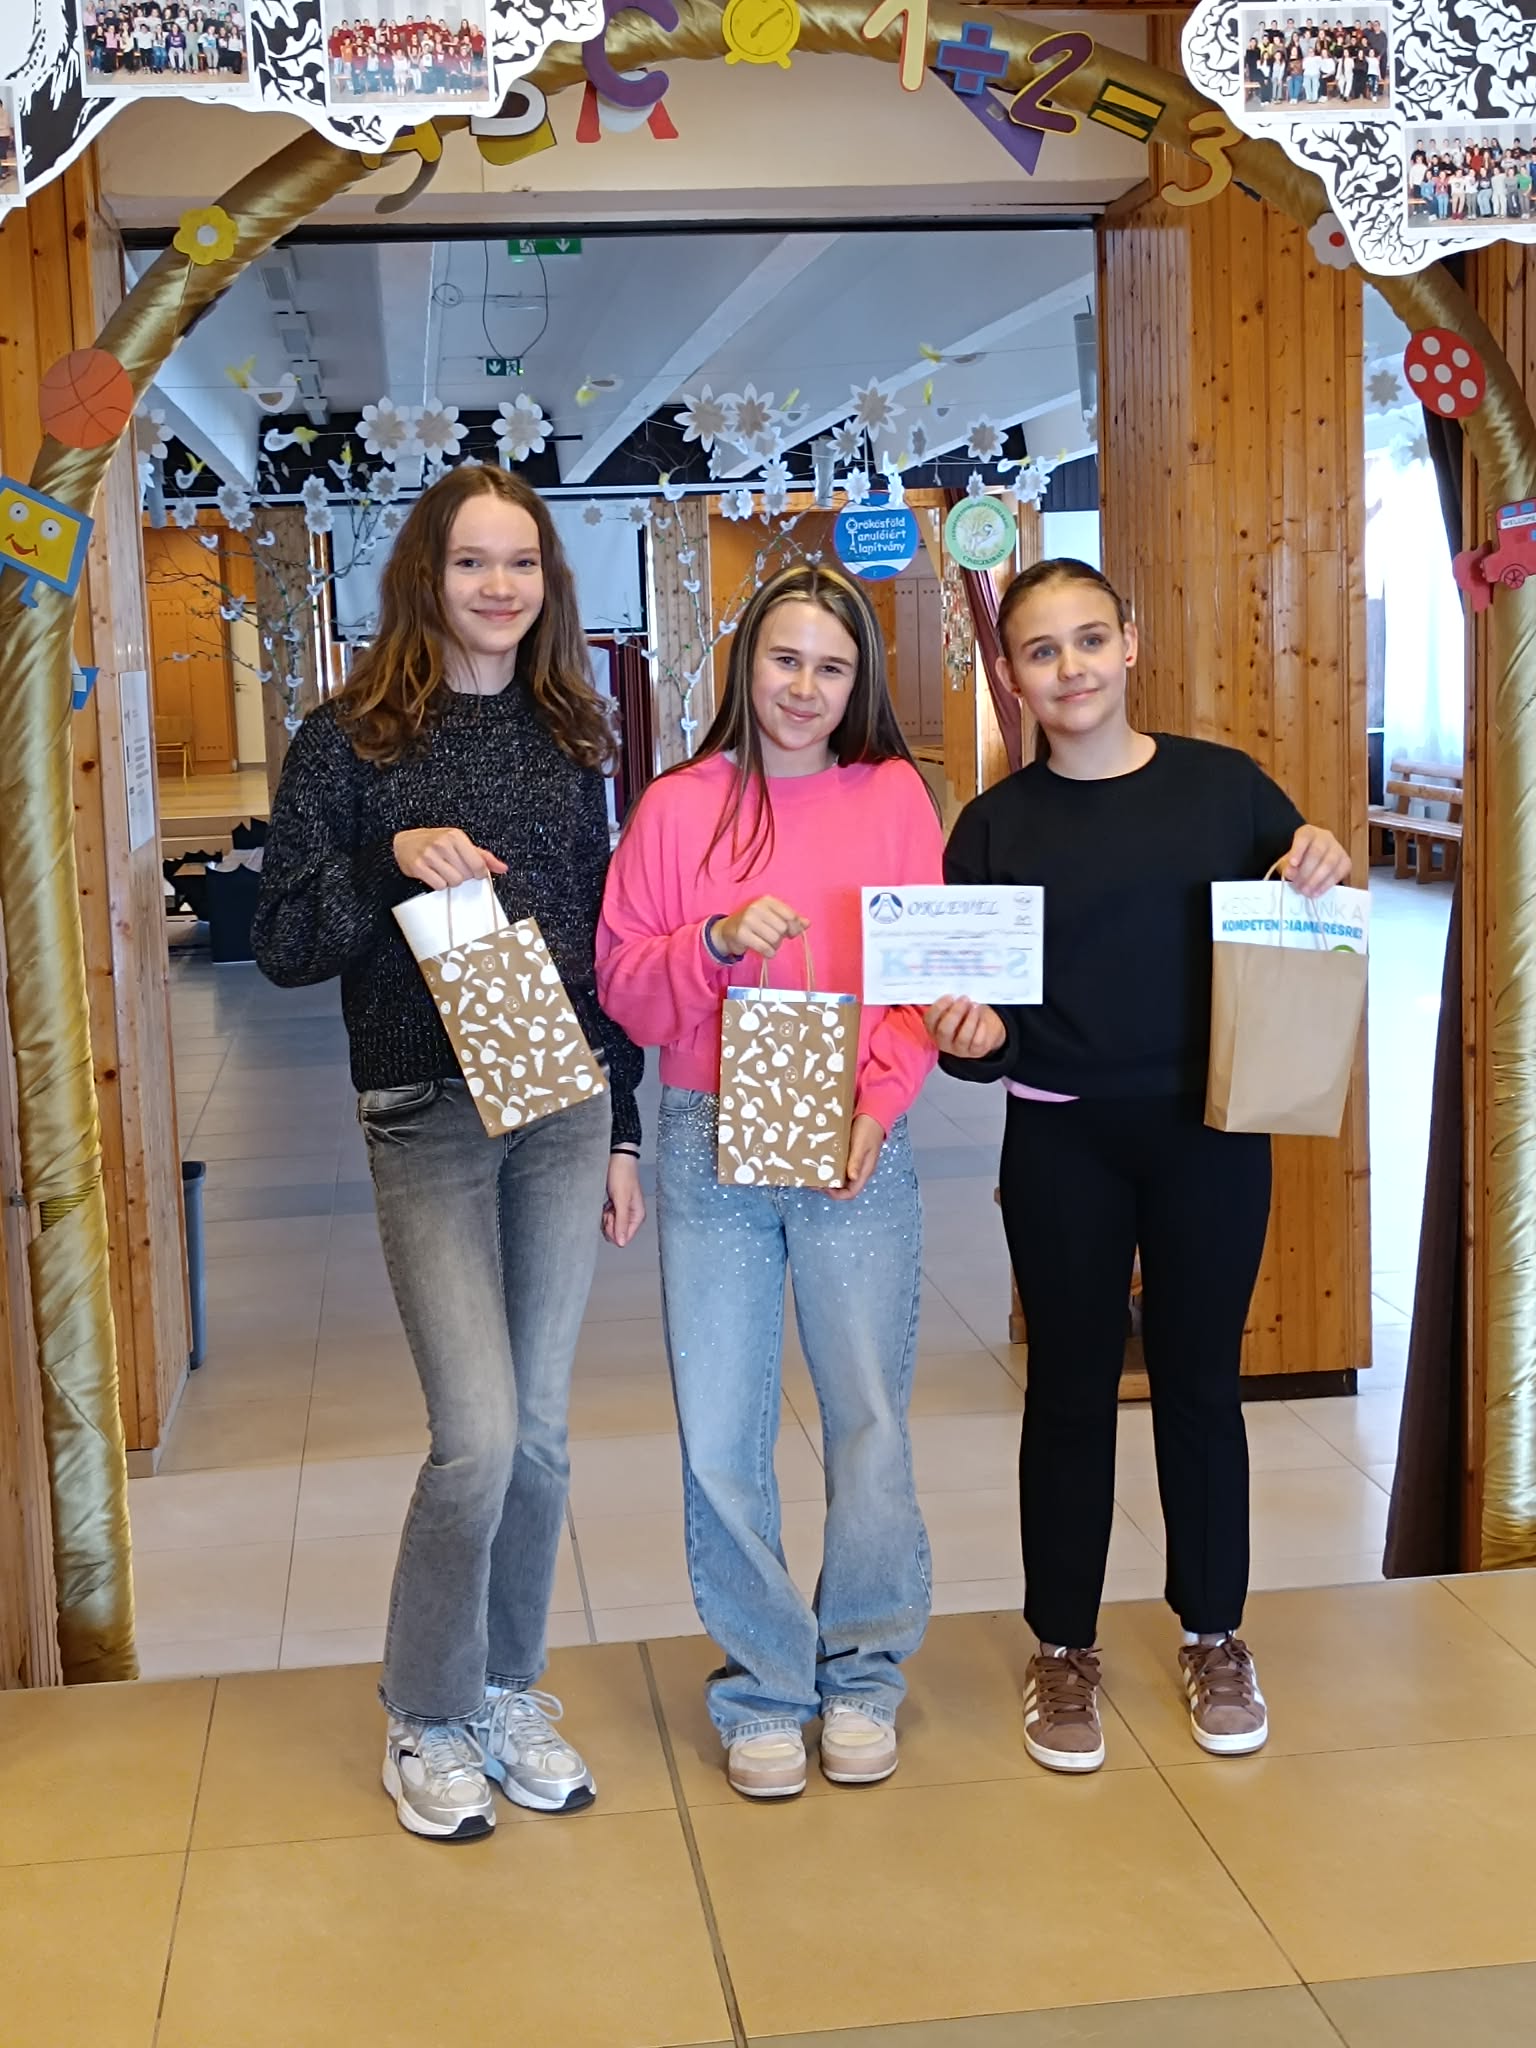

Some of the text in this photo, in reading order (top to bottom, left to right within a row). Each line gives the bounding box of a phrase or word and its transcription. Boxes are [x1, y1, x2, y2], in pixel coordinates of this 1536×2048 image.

[862, 0, 929, 92] 1
[1008, 30, 1095, 137] 2
[1160, 109, 1245, 207] 3
